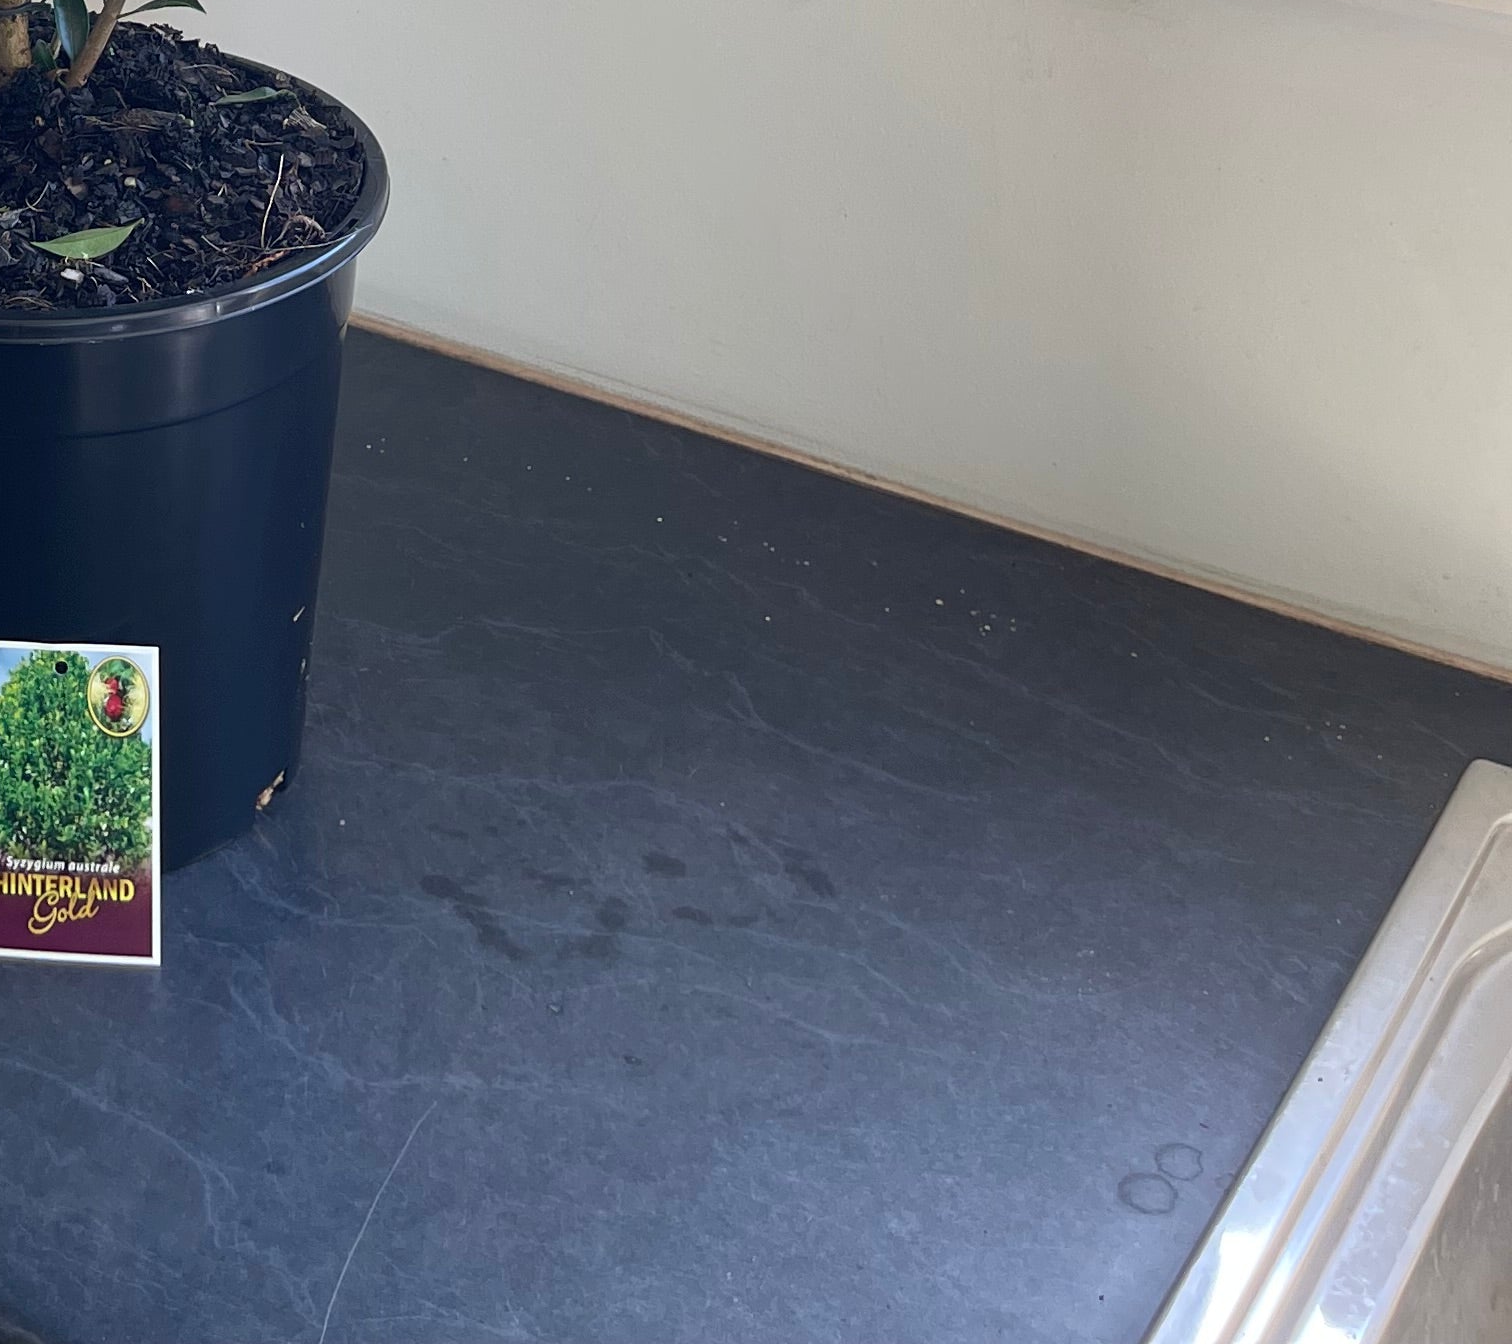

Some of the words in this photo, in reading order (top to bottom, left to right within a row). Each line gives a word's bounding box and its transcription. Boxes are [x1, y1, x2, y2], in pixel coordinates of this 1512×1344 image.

[5, 855, 65, 872] Syzygium
[68, 860, 121, 874] australe
[27, 889, 99, 935] Gold
